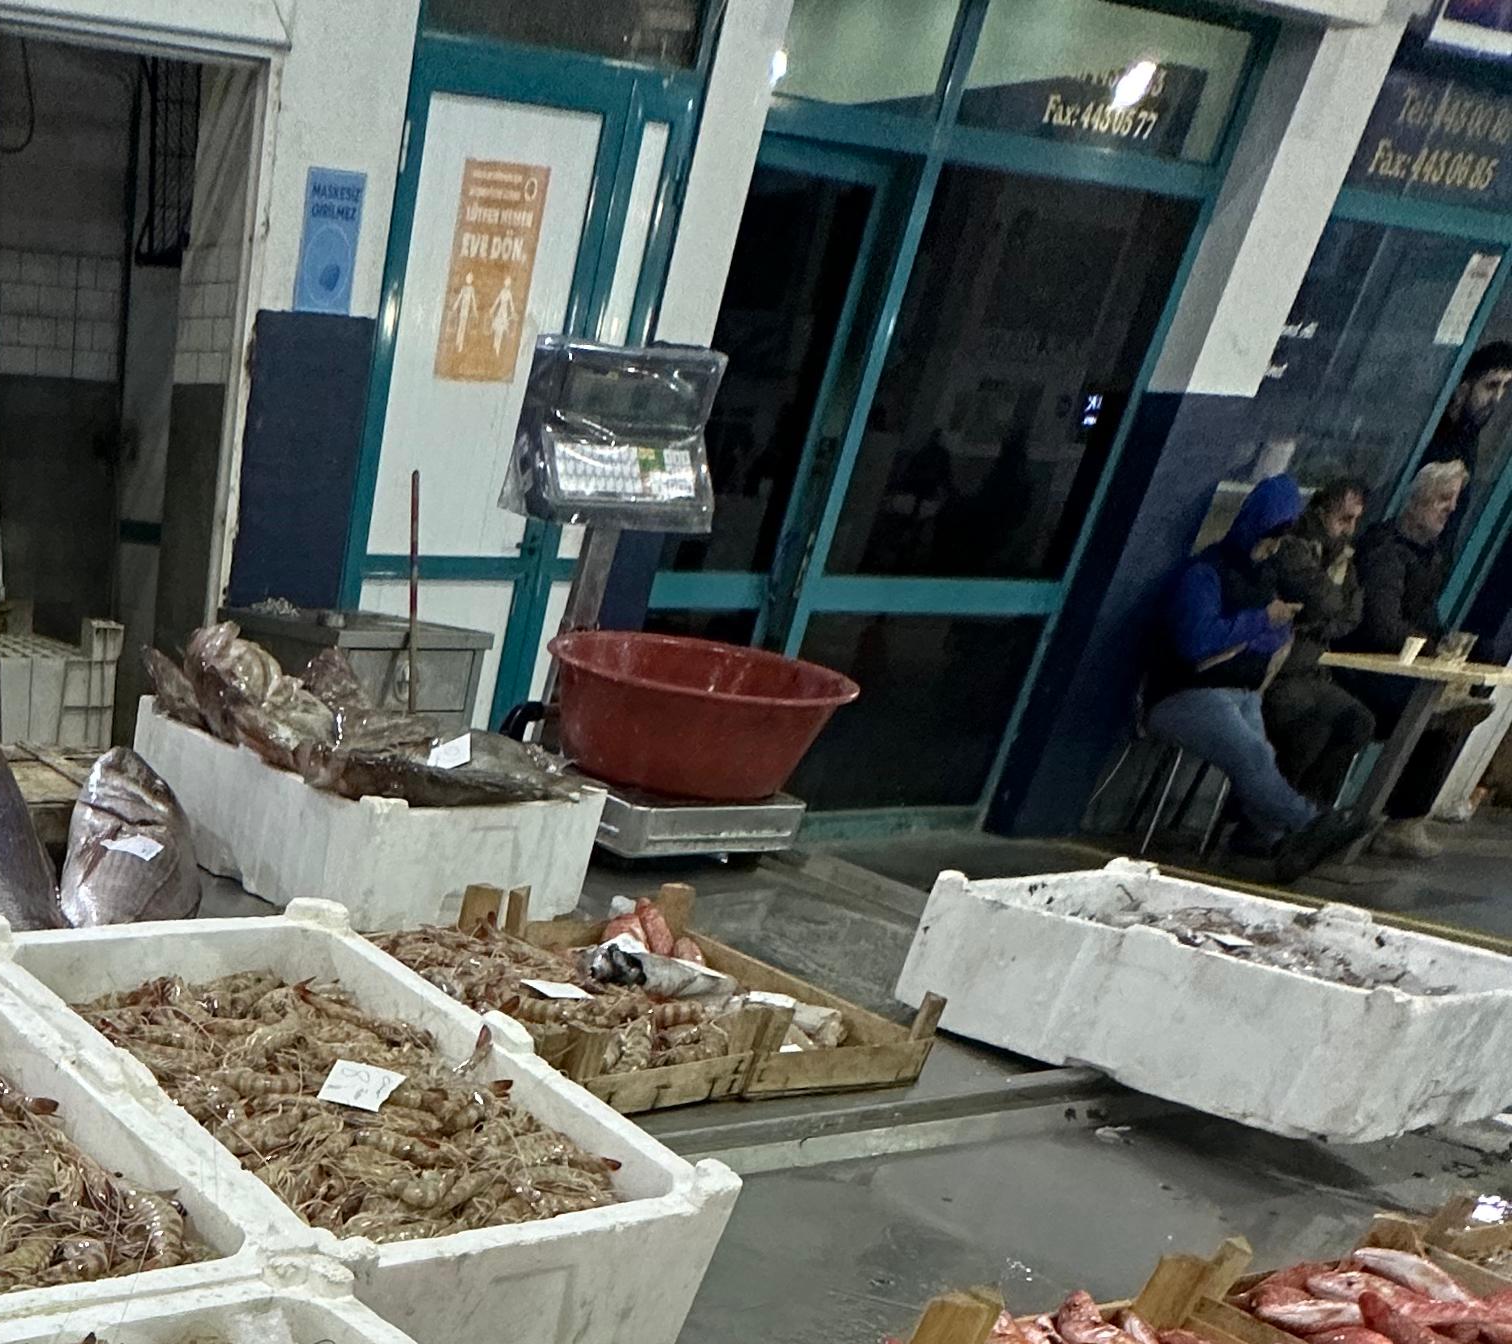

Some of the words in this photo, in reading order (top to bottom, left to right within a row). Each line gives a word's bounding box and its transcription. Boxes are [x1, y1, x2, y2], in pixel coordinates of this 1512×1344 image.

[1043, 92, 1080, 128] Fax:
[1133, 110, 1158, 141] 77
[1368, 138, 1413, 179] Fax:
